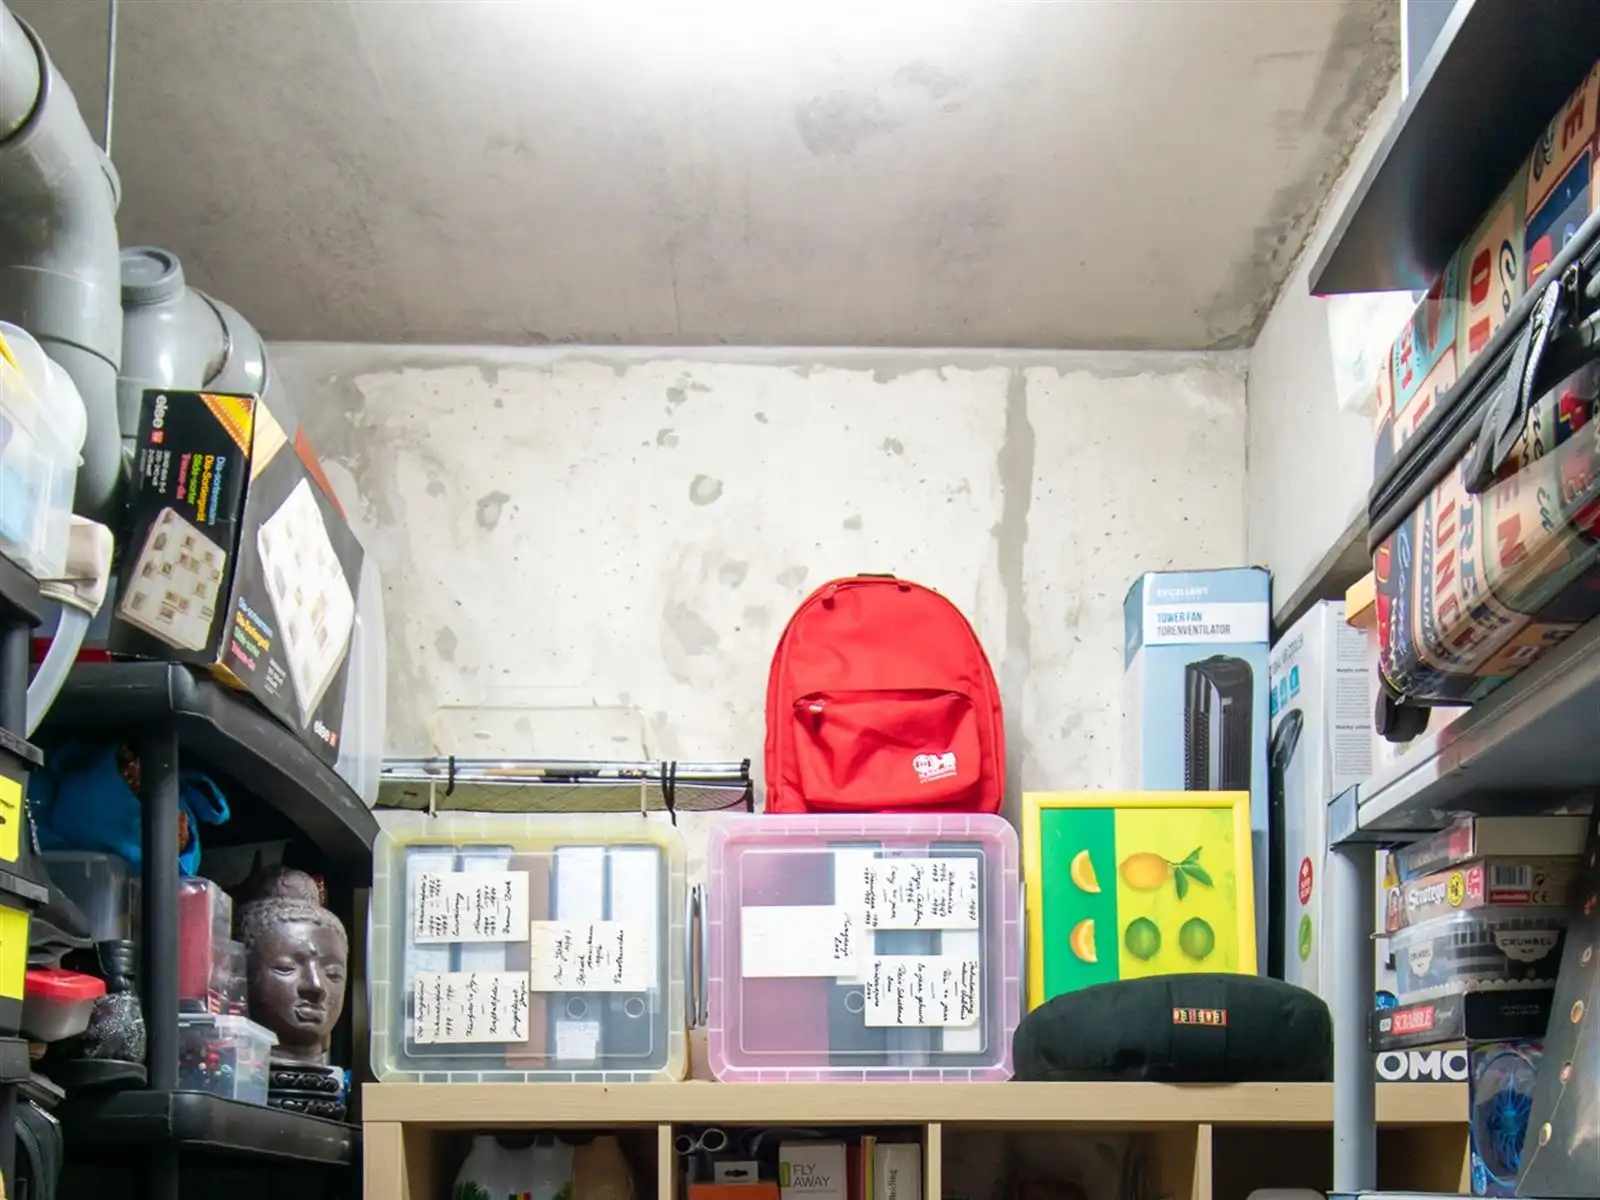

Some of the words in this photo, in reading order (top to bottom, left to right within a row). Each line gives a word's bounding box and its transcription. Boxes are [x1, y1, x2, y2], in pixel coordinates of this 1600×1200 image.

[1156, 612, 1186, 624] TOWER
[1187, 611, 1203, 622] FAN
[1156, 624, 1231, 637] TORENVENTILATOR
[792, 1163, 816, 1176] FLY
[792, 1176, 832, 1188] AWAY
